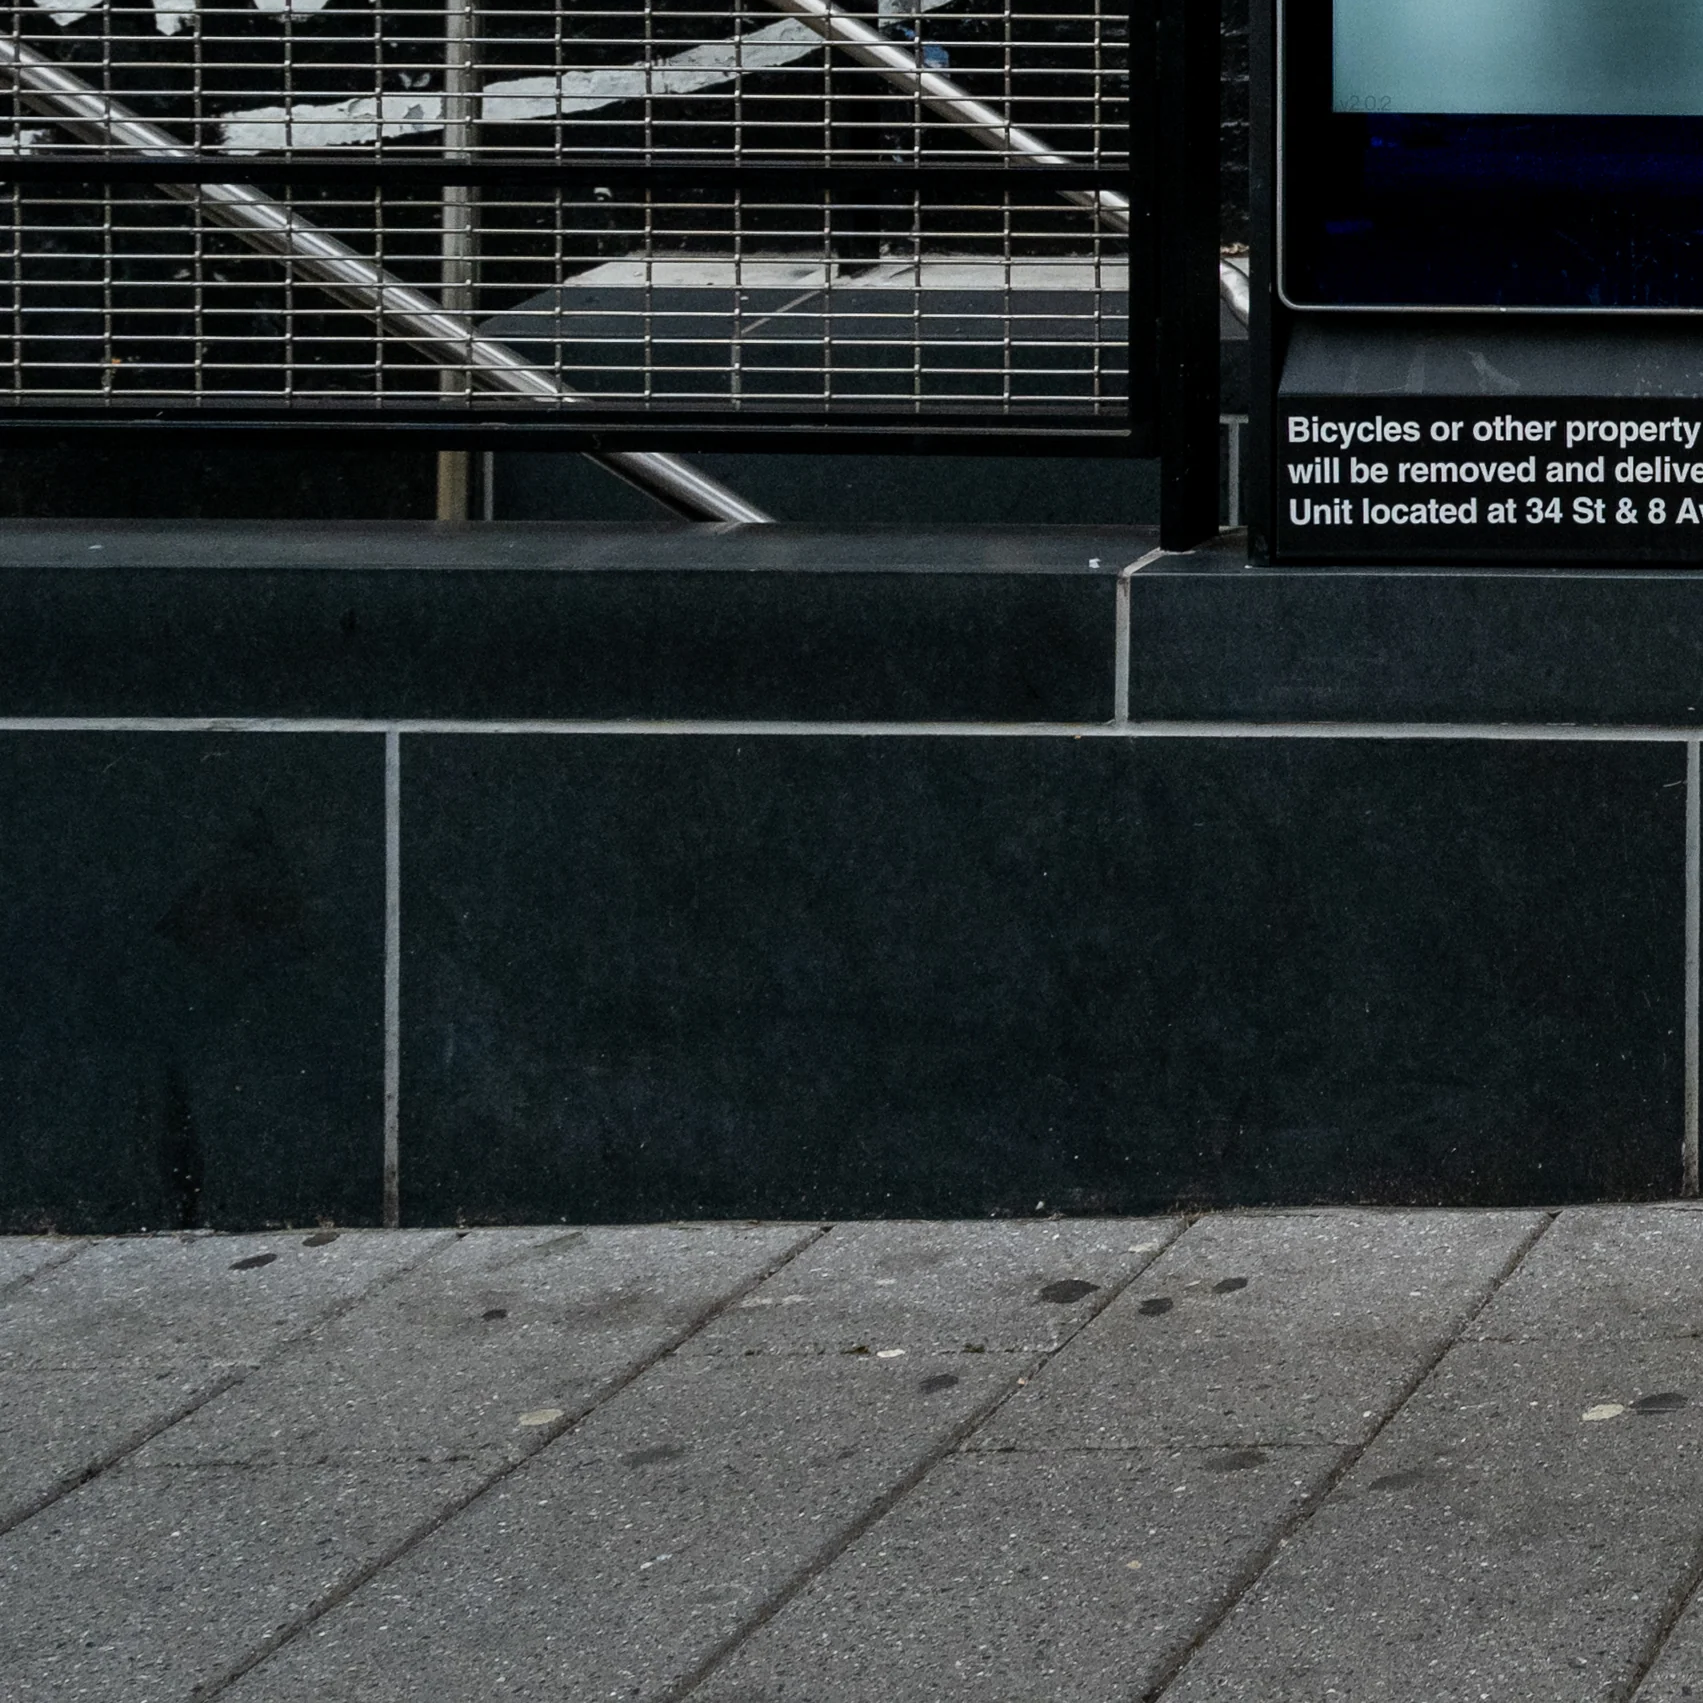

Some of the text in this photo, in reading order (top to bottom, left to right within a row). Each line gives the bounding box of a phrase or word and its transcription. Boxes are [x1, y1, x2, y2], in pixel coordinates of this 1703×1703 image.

[1288, 415, 1421, 449] Bicycles
[1430, 421, 1464, 442] or
[1472, 415, 1557, 442] other
[1566, 417, 1702, 449] property
[1287, 457, 1339, 484] will
[1350, 457, 1389, 484] be
[1398, 456, 1536, 483] removed
[1545, 456, 1604, 483] and
[1289, 498, 1353, 525] Unit
[1362, 497, 1477, 525] located
[1486, 498, 1517, 524] at
[1525, 497, 1563, 524] 34
[1572, 496, 1606, 524] St
[1615, 497, 1639, 524] &
[1647, 497, 1667, 524] 8
